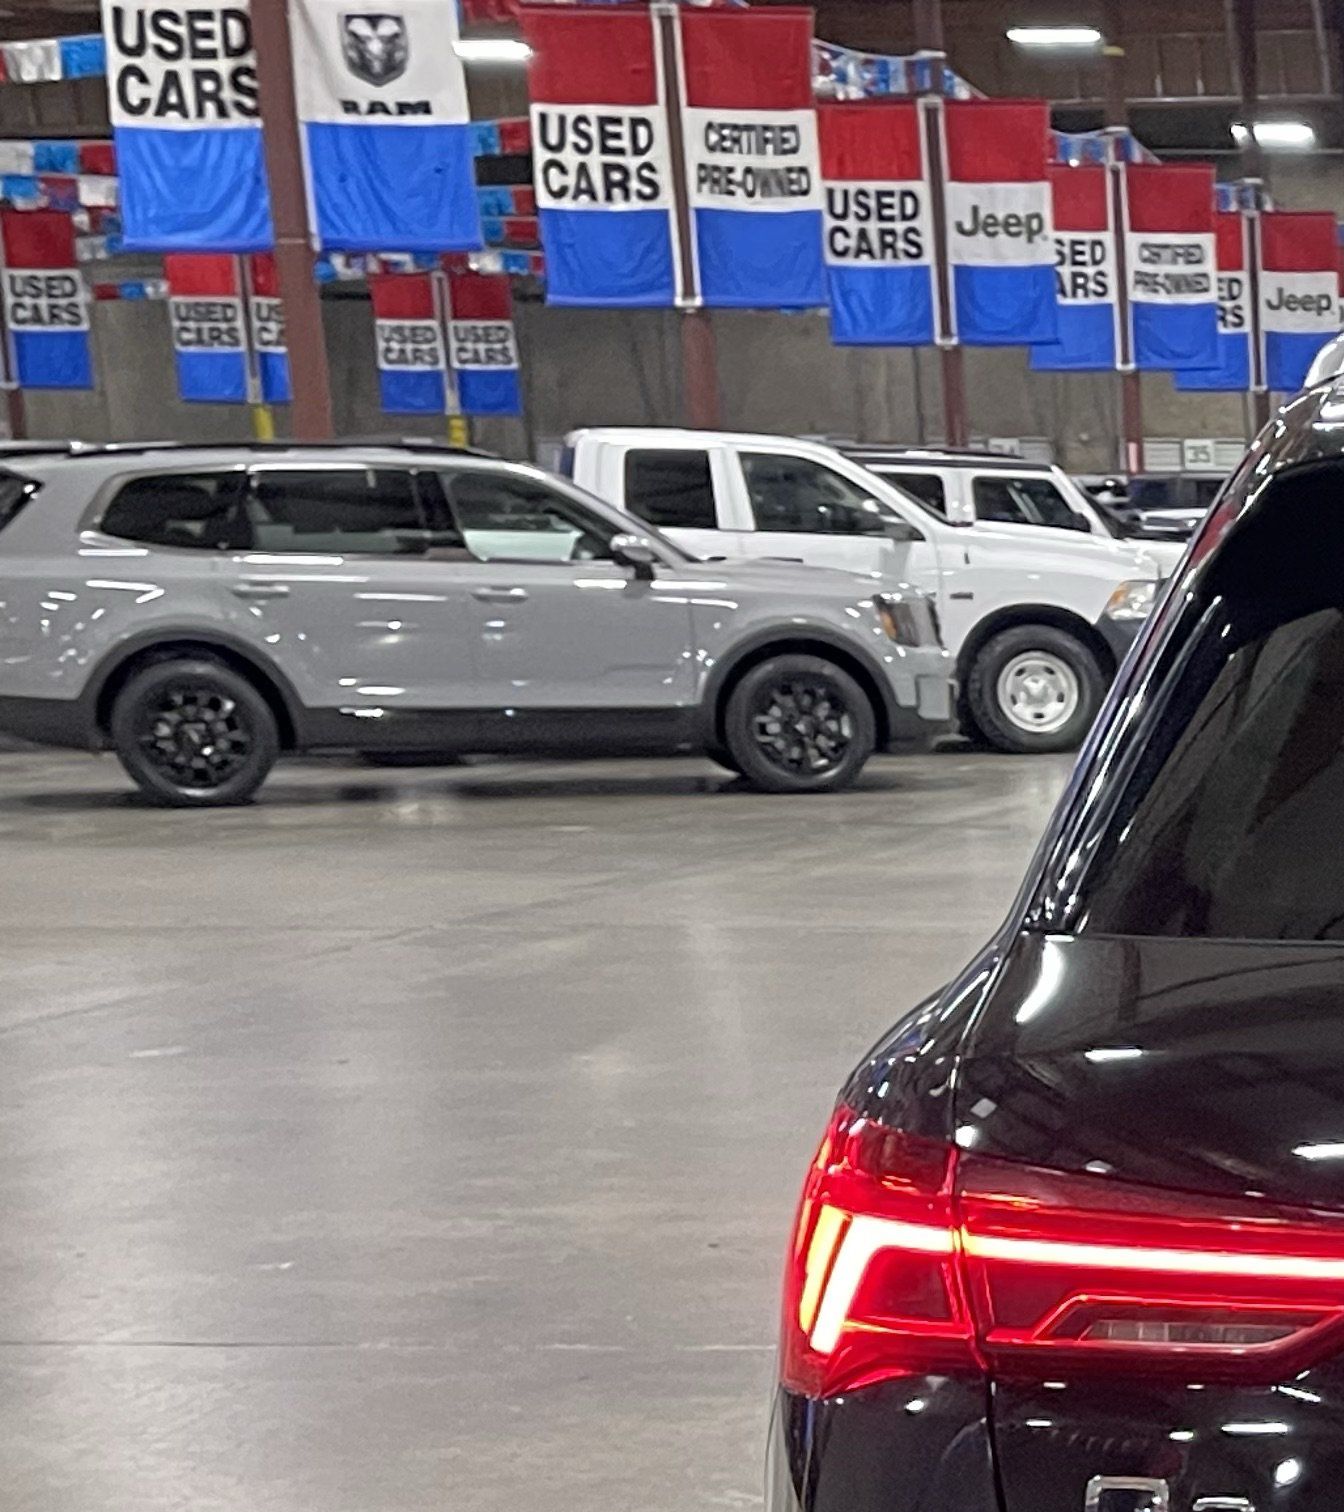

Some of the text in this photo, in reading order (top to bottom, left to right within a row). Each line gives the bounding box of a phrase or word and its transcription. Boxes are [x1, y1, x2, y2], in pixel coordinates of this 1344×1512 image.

[112, 6, 251, 61] USED
[117, 64, 260, 119] CARS
[538, 112, 653, 157] USED
[542, 159, 660, 201] CARS
[826, 188, 918, 222] USED
[954, 204, 1044, 243] Jeep
[829, 226, 923, 260] CARS
[1054, 239, 1106, 266] SED
[9, 274, 77, 298] USED
[1217, 277, 1242, 300] ED
[175, 302, 236, 322] USED
[255, 302, 284, 323] US
[1266, 287, 1333, 316] Jeep
[11, 302, 82, 326] CARS
[1217, 304, 1244, 328] RS
[176, 327, 240, 347] CARS
[377, 325, 436, 344] USED
[453, 325, 509, 343] USED
[382, 348, 439, 365] CARS
[455, 348, 513, 365] CARS
